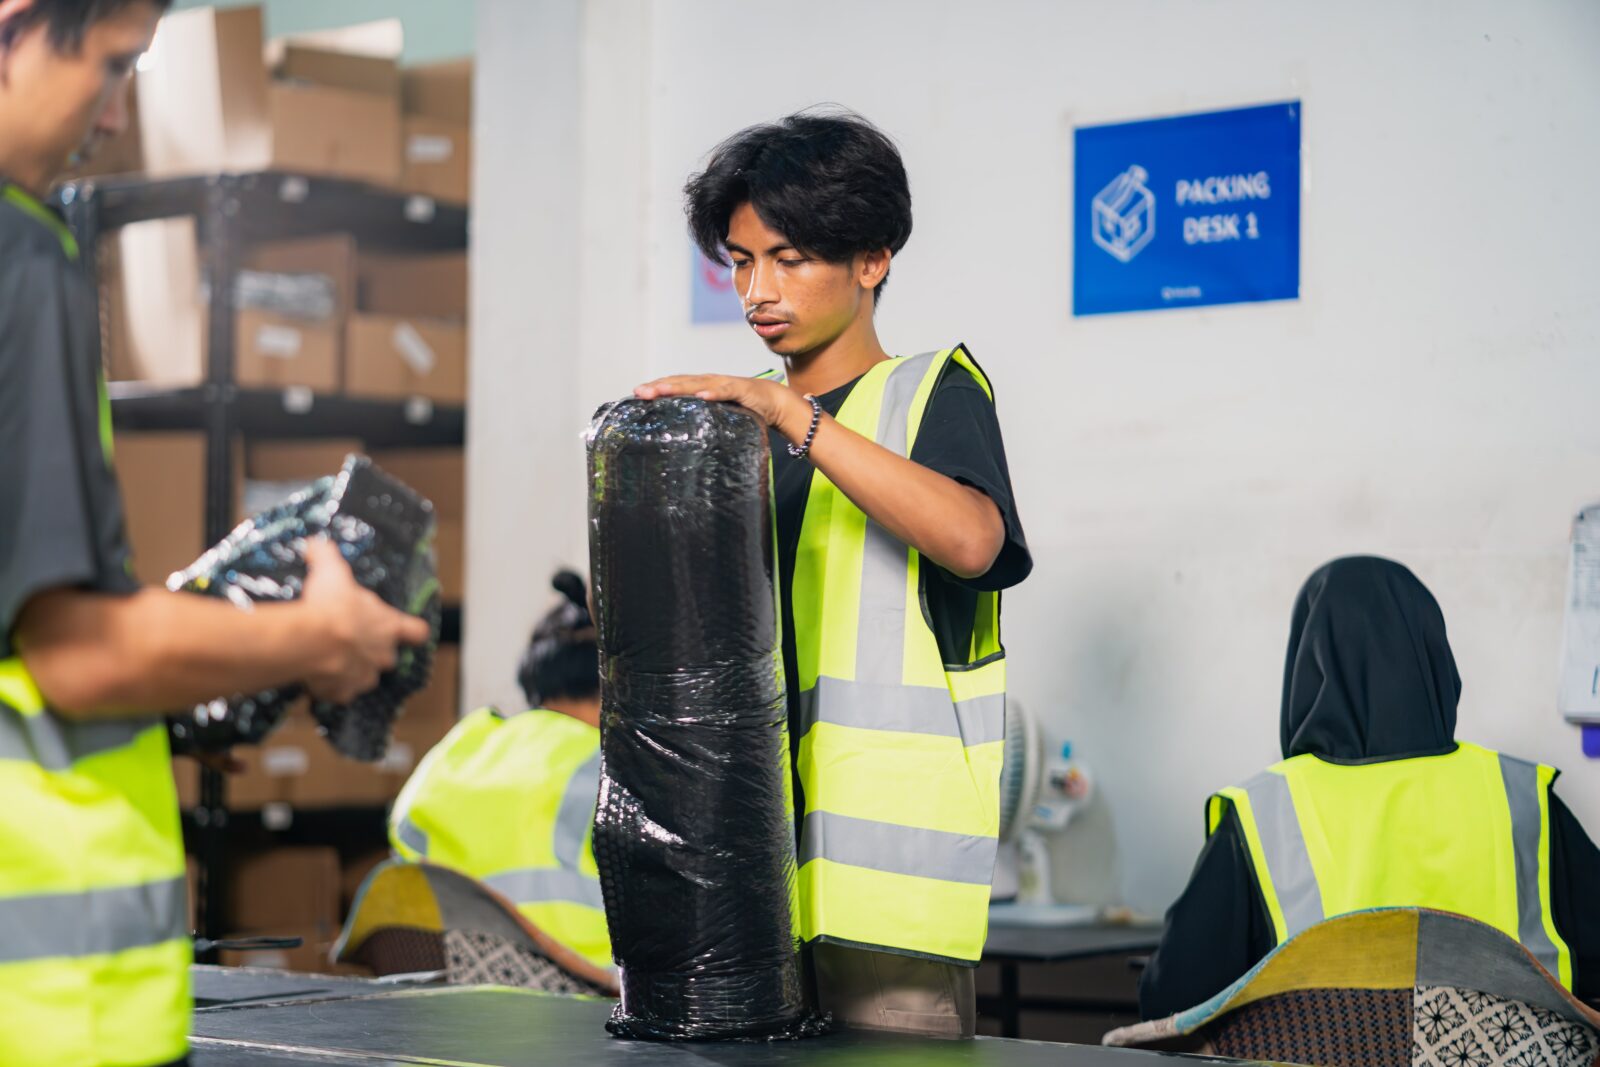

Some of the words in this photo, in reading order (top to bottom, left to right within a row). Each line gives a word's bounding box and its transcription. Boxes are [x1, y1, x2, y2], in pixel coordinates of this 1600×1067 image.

[1176, 171, 1270, 205] PACKING
[1183, 214, 1240, 244] DESK
[1245, 212, 1259, 239] 1
